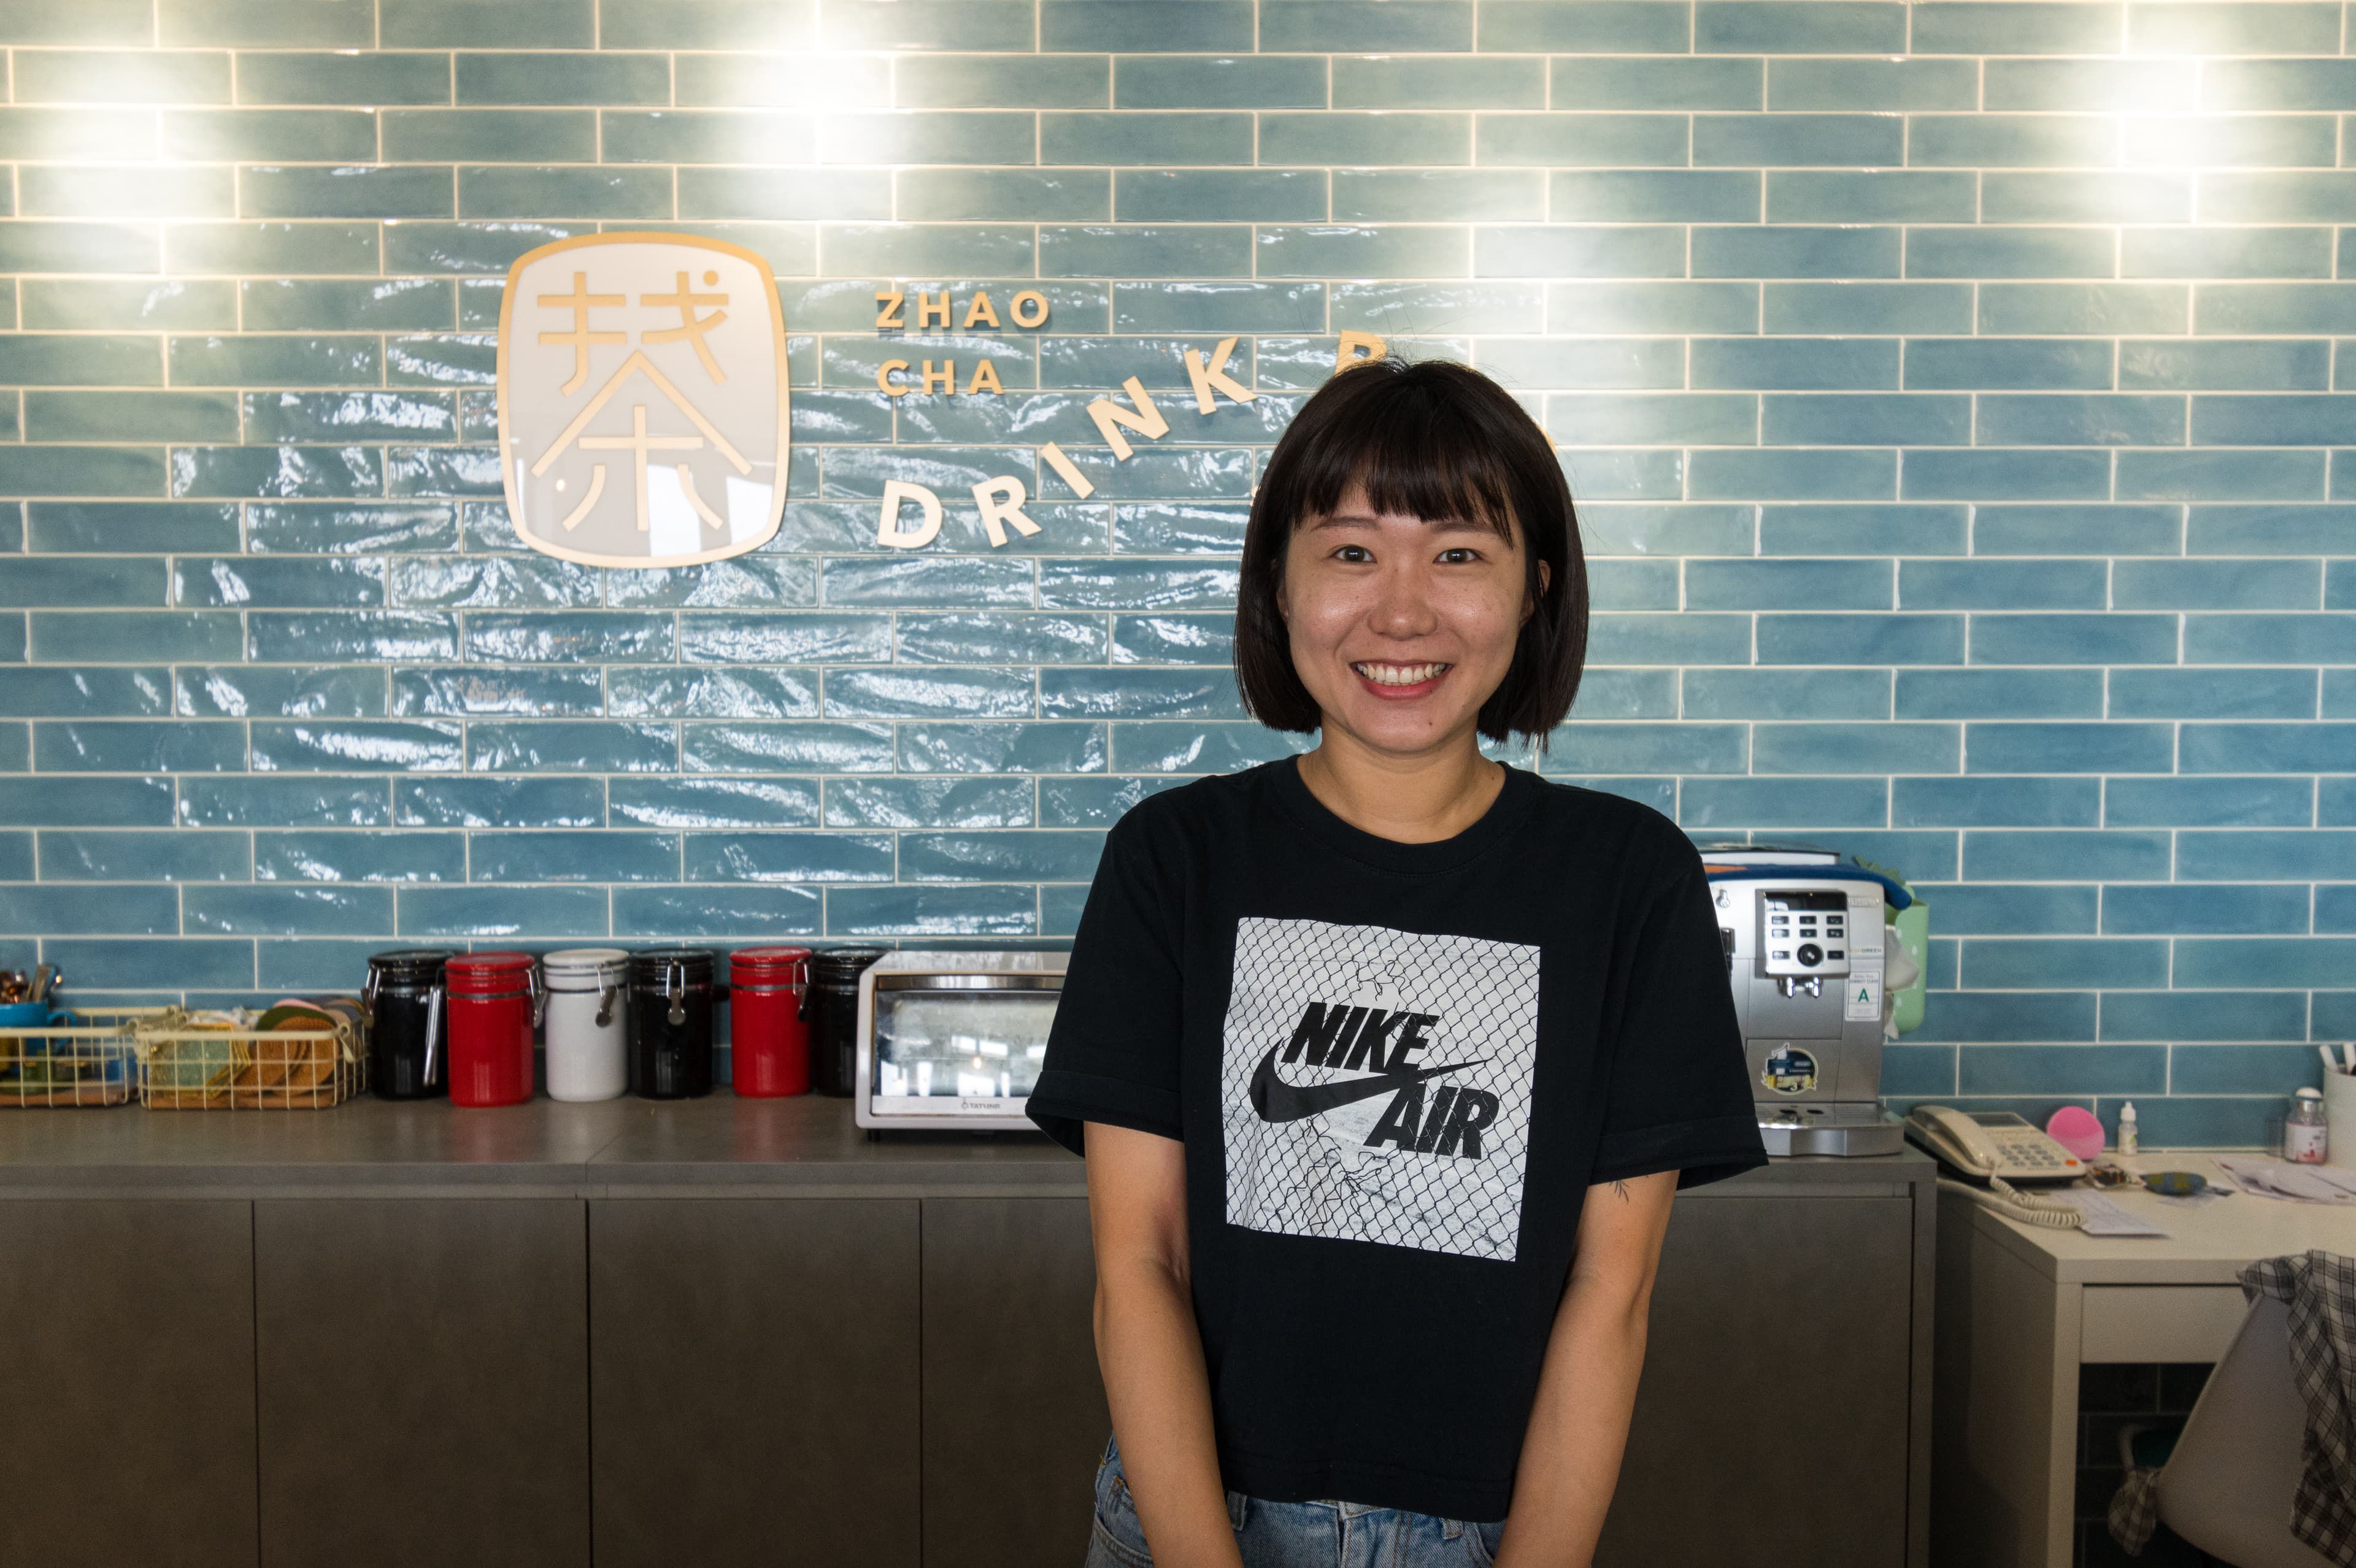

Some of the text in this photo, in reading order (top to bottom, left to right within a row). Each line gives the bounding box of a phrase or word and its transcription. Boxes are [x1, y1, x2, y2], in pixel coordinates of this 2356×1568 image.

[876, 290, 1049, 328] ZHAO
[877, 359, 1004, 396] CHA
[877, 337, 1258, 548] DRINK
[1858, 988, 1869, 1002] A
[1281, 1001, 1440, 1072] NIKE
[1363, 1081, 1499, 1159] AIR
